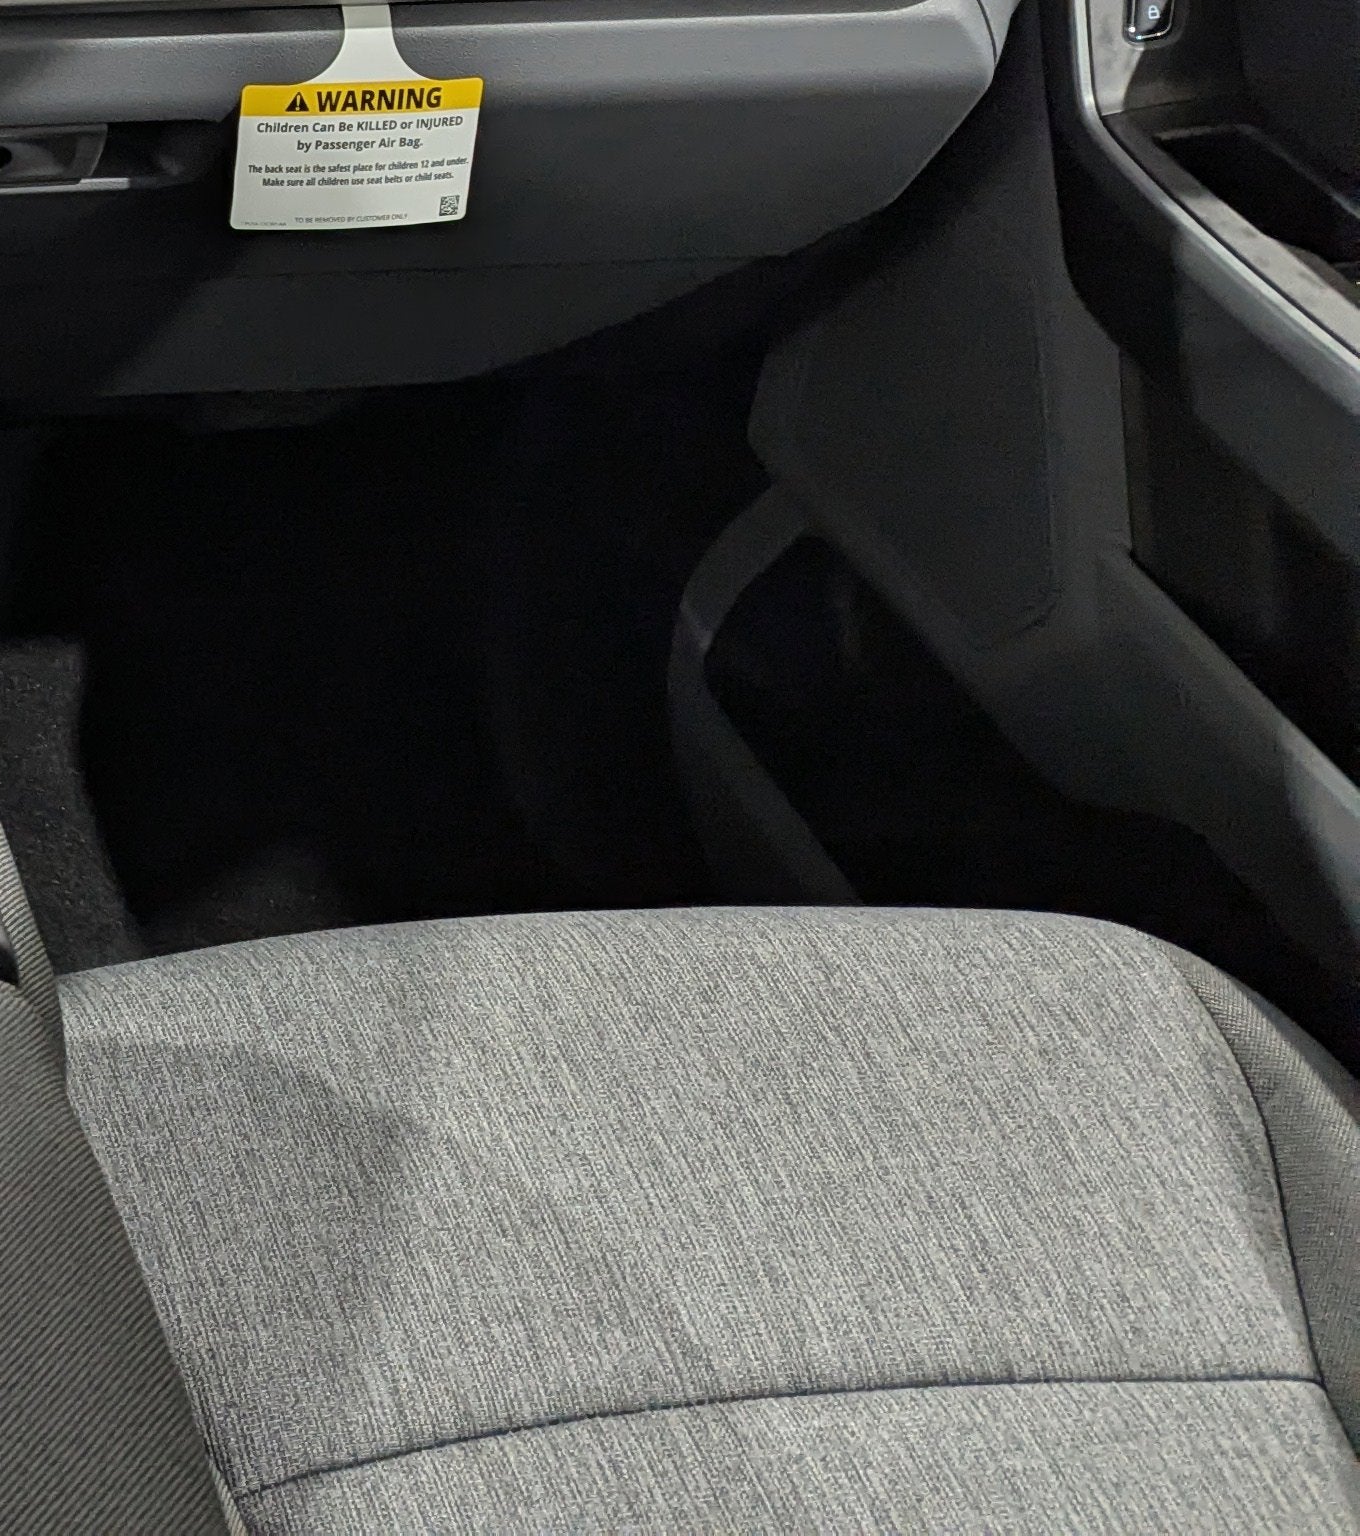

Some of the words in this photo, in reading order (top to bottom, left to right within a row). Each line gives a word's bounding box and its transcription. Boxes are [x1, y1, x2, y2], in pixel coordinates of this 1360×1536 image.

[316, 86, 443, 113] WARNING
[256, 121, 309, 134] Children
[312, 121, 335, 133] Can
[338, 121, 354, 132] Be
[356, 119, 398, 132] KILLED
[400, 120, 412, 130] or
[416, 115, 464, 131] INJURED
[296, 139, 313, 154] by
[314, 139, 376, 152] Passenger
[378, 137, 397, 149] Air
[399, 136, 424, 150] Bag.
[248, 164, 263, 174] The
[264, 164, 284, 174] back
[285, 165, 302, 174] seat
[304, 164, 311, 173] is
[312, 164, 326, 173] the
[328, 163, 351, 173] safest
[352, 163, 373, 175] place
[375, 162, 387, 172] for
[388, 160, 419, 171] children
[420, 160, 430, 169] 12
[430, 158, 445, 168] and
[262, 177, 285, 187] Make
[286, 178, 304, 187] sure
[305, 176, 316, 186] all
[317, 176, 350, 186] children
[351, 177, 365, 186] use
[366, 176, 383, 185] seat
[384, 174, 403, 184] belts
[404, 175, 413, 183] or
[414, 172, 432, 182] child
[356, 214, 390, 223] CUSTOMER
